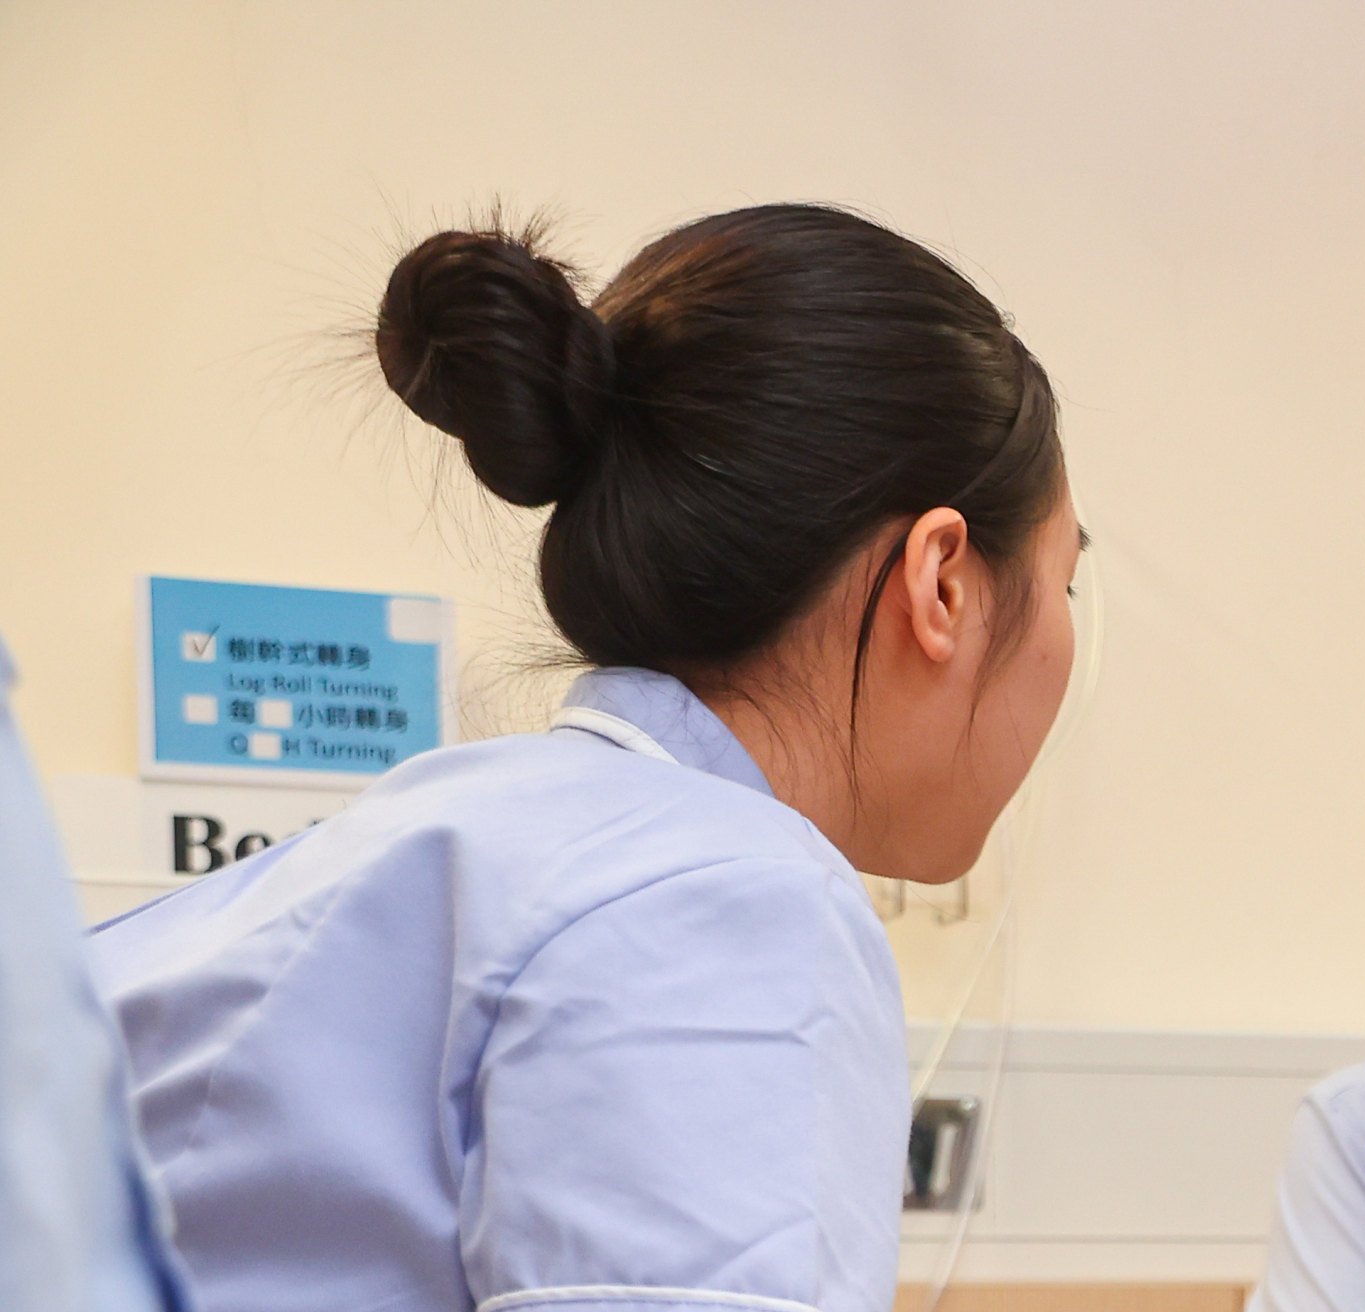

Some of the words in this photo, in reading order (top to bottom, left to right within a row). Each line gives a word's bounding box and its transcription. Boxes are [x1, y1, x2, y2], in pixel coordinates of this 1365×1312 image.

[229, 636, 371, 671] 樹幹式轉身
[228, 674, 265, 695] Log
[273, 675, 312, 694] Roll
[318, 677, 398, 704] Turning
[309, 737, 396, 764] Turning
